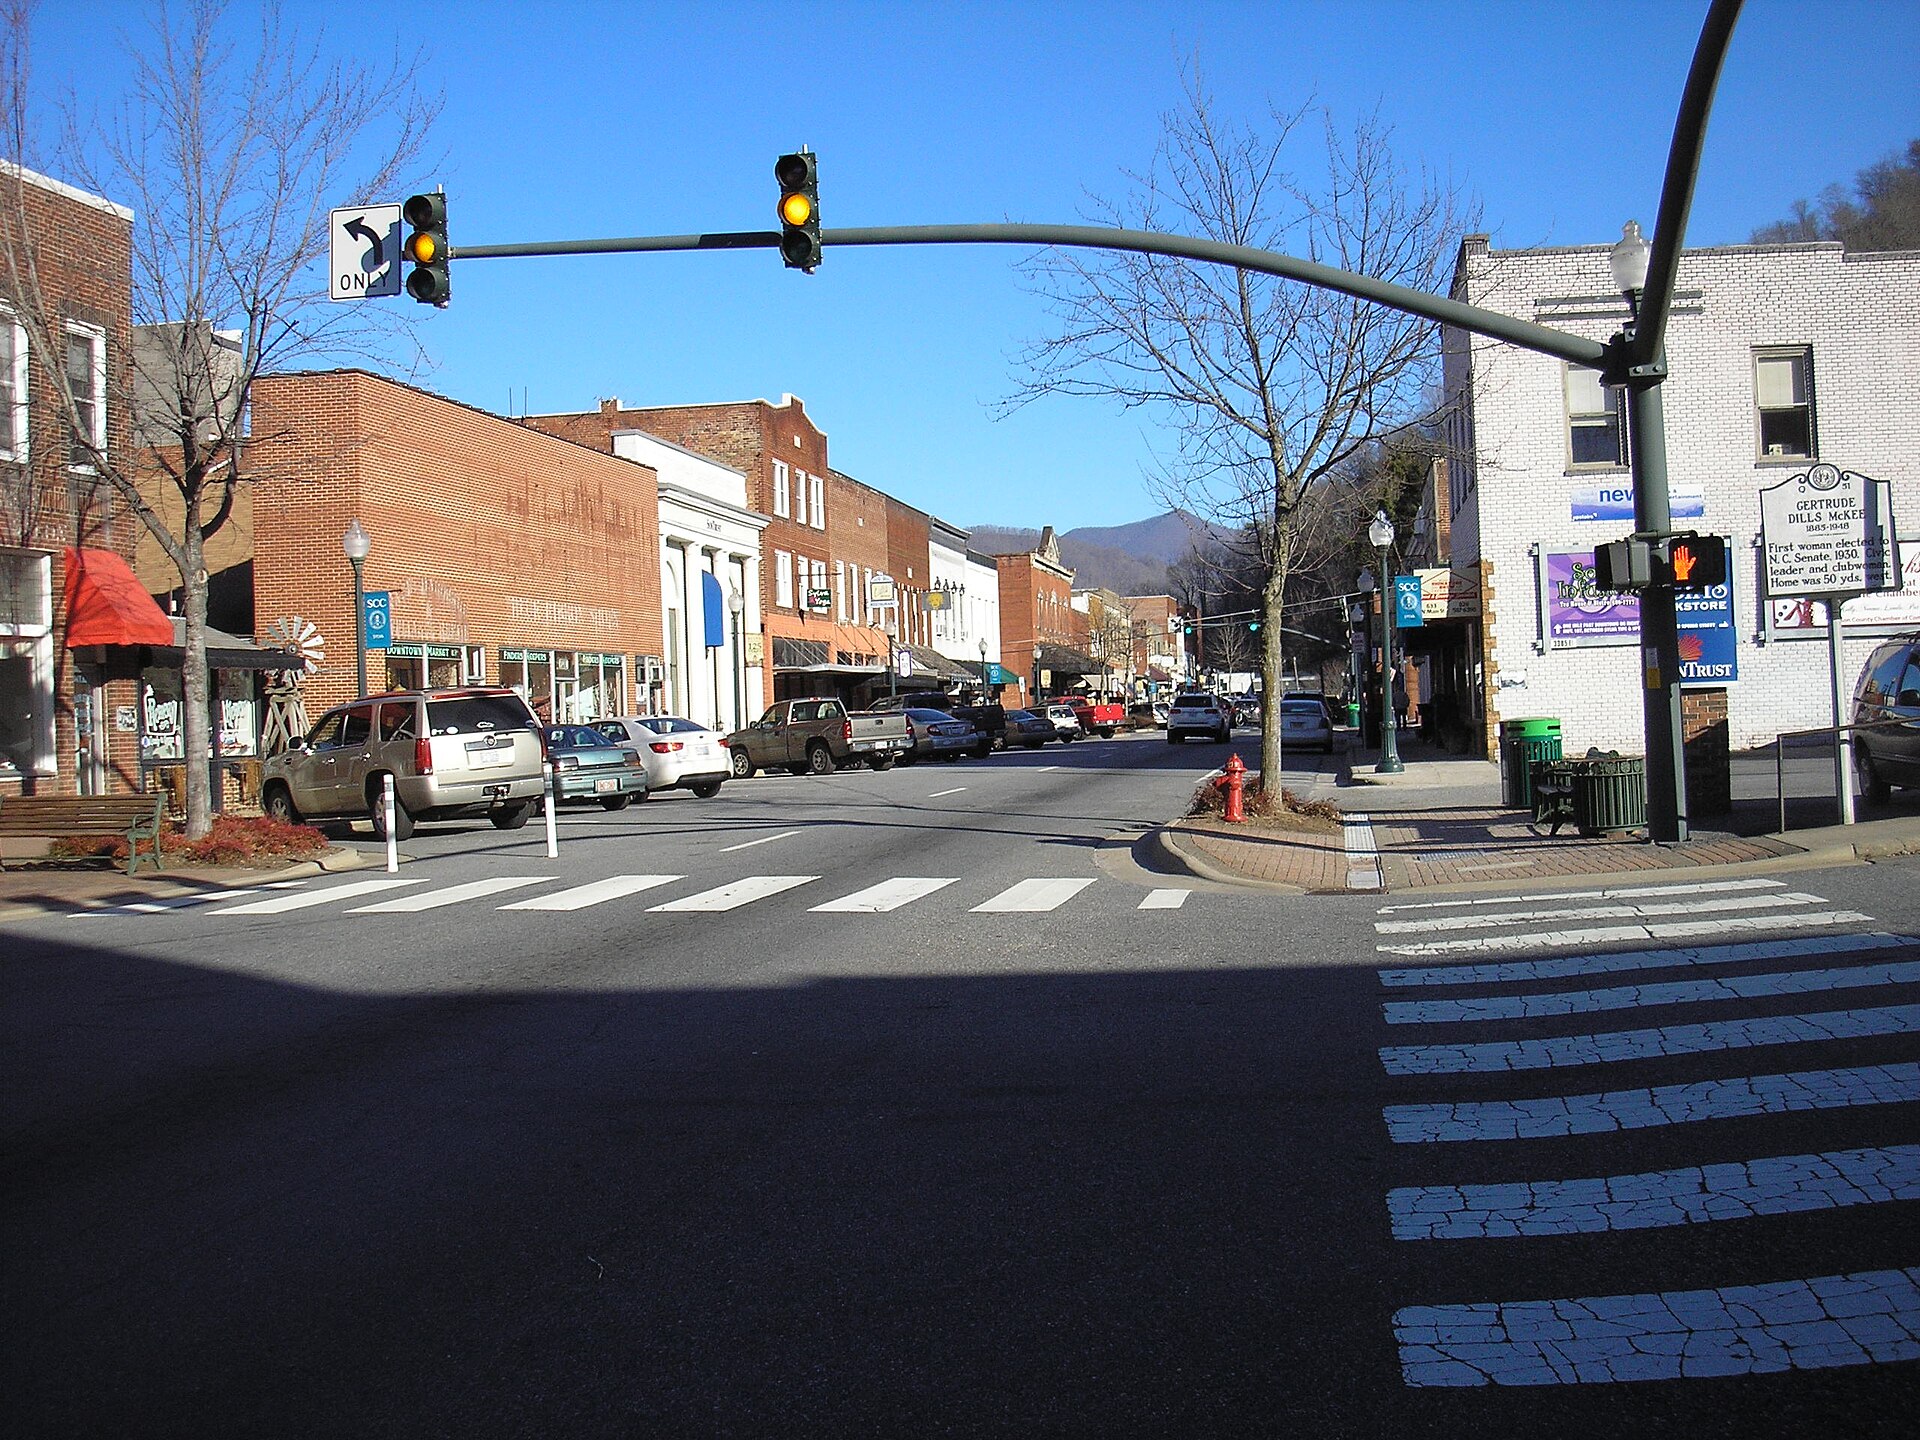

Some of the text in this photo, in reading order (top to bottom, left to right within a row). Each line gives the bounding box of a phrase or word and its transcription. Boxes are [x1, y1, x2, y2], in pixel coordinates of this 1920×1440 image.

[340, 271, 388, 290] ONLY
[1796, 498, 1856, 510] GERTRUDE
[1788, 509, 1866, 524] DILLS McKEE
[1806, 522, 1850, 532] 1885-1948
[1768, 536, 1889, 553] First woman elected to
[1835, 549, 1860, 560] 1930.
[1866, 548, 1890, 557] Civic
[1572, 562, 1596, 580] So
[1770, 566, 1804, 576] leader
[1808, 564, 1828, 573] and
[1832, 560, 1891, 572] clubwoman.
[1771, 569, 1892, 588] Home was 50 yds. west.
[1398, 583, 1418, 591] SCC
[808, 590, 829, 598] Sylva
[366, 598, 387, 608] SCC
[815, 598, 830, 606] Yoga
[1675, 601, 1727, 611] KSTORE
[386, 646, 422, 656] DOWNTOWN
[427, 646, 449, 657] MARKET
[1679, 662, 1732, 677] NTRUST
